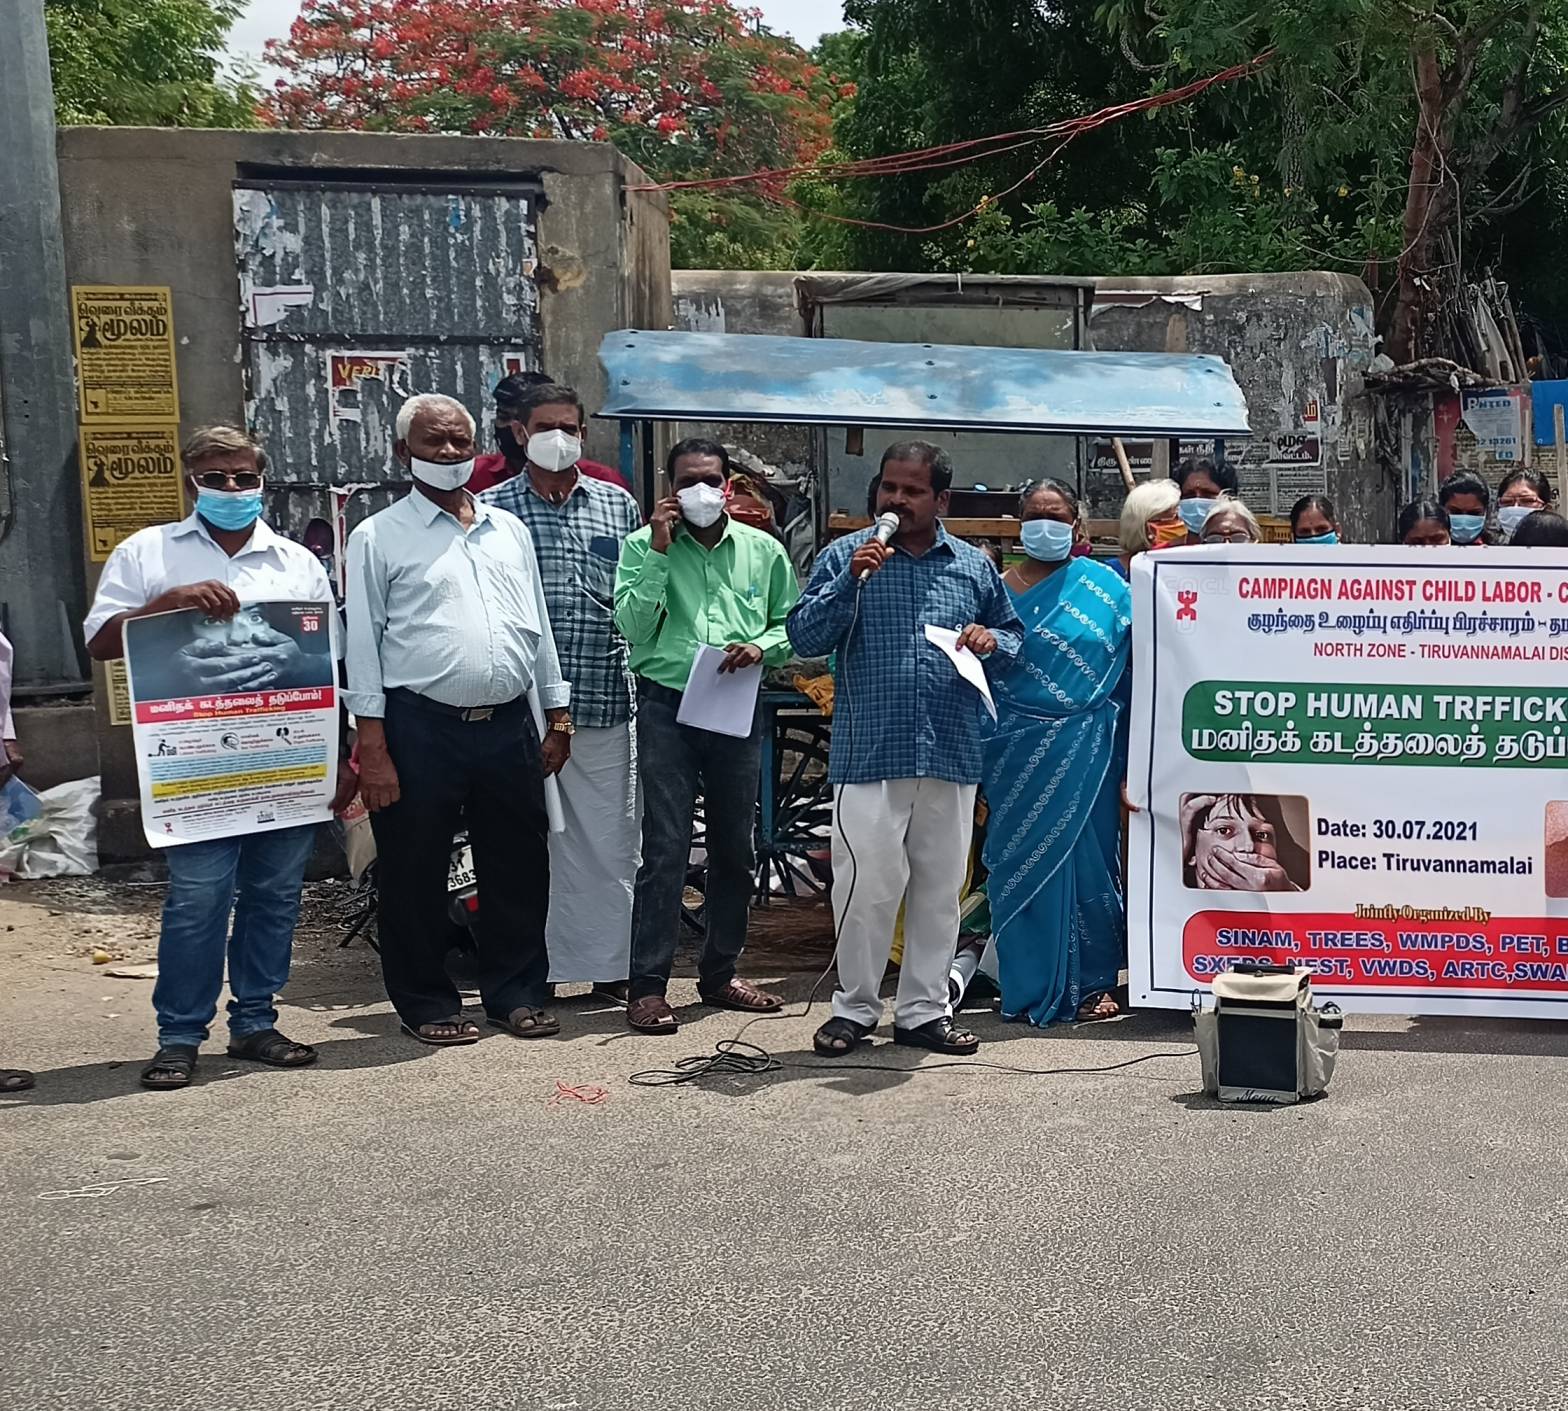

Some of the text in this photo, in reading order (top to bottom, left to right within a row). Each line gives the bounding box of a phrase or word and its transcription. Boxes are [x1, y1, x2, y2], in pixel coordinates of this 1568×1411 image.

[1238, 577, 1332, 600] CAMPIAGN
[1337, 579, 1416, 601] AGAINST
[1422, 580, 1476, 602] CHILD
[1481, 581, 1541, 603] LABOR
[303, 620, 318, 631] 30
[1248, 607, 1315, 634] குழந்தை
[1318, 608, 1387, 635] உழைப்பு
[1390, 609, 1449, 635] எதிர்ப்பு
[1453, 609, 1535, 636] பிரச்சாரம்
[1314, 642, 1363, 657] NORTH
[1367, 643, 1406, 658] ZONE
[1419, 644, 1544, 661] TIRUVANNAMALAI
[150, 700, 194, 713] மனிதக்
[200, 695, 264, 711] கடத்தலைத்
[1214, 690, 1297, 717] STOP
[1306, 692, 1423, 719] HUMAN
[1191, 720, 1301, 759] மனிதக்
[1309, 721, 1487, 762] கடத்தலைத்
[1317, 818, 1478, 841] Date: 30.07.2021
[1318, 850, 1533, 875] Place: Tiruvannamalai
[1354, 903, 1491, 925] Jointly Organized By
[1216, 929, 1300, 952] SINAM,
[1307, 931, 1392, 953] TREES,
[1398, 932, 1493, 956] WMPDS,
[1500, 934, 1550, 957] PET,
[1360, 958, 1437, 980] VWDS,
